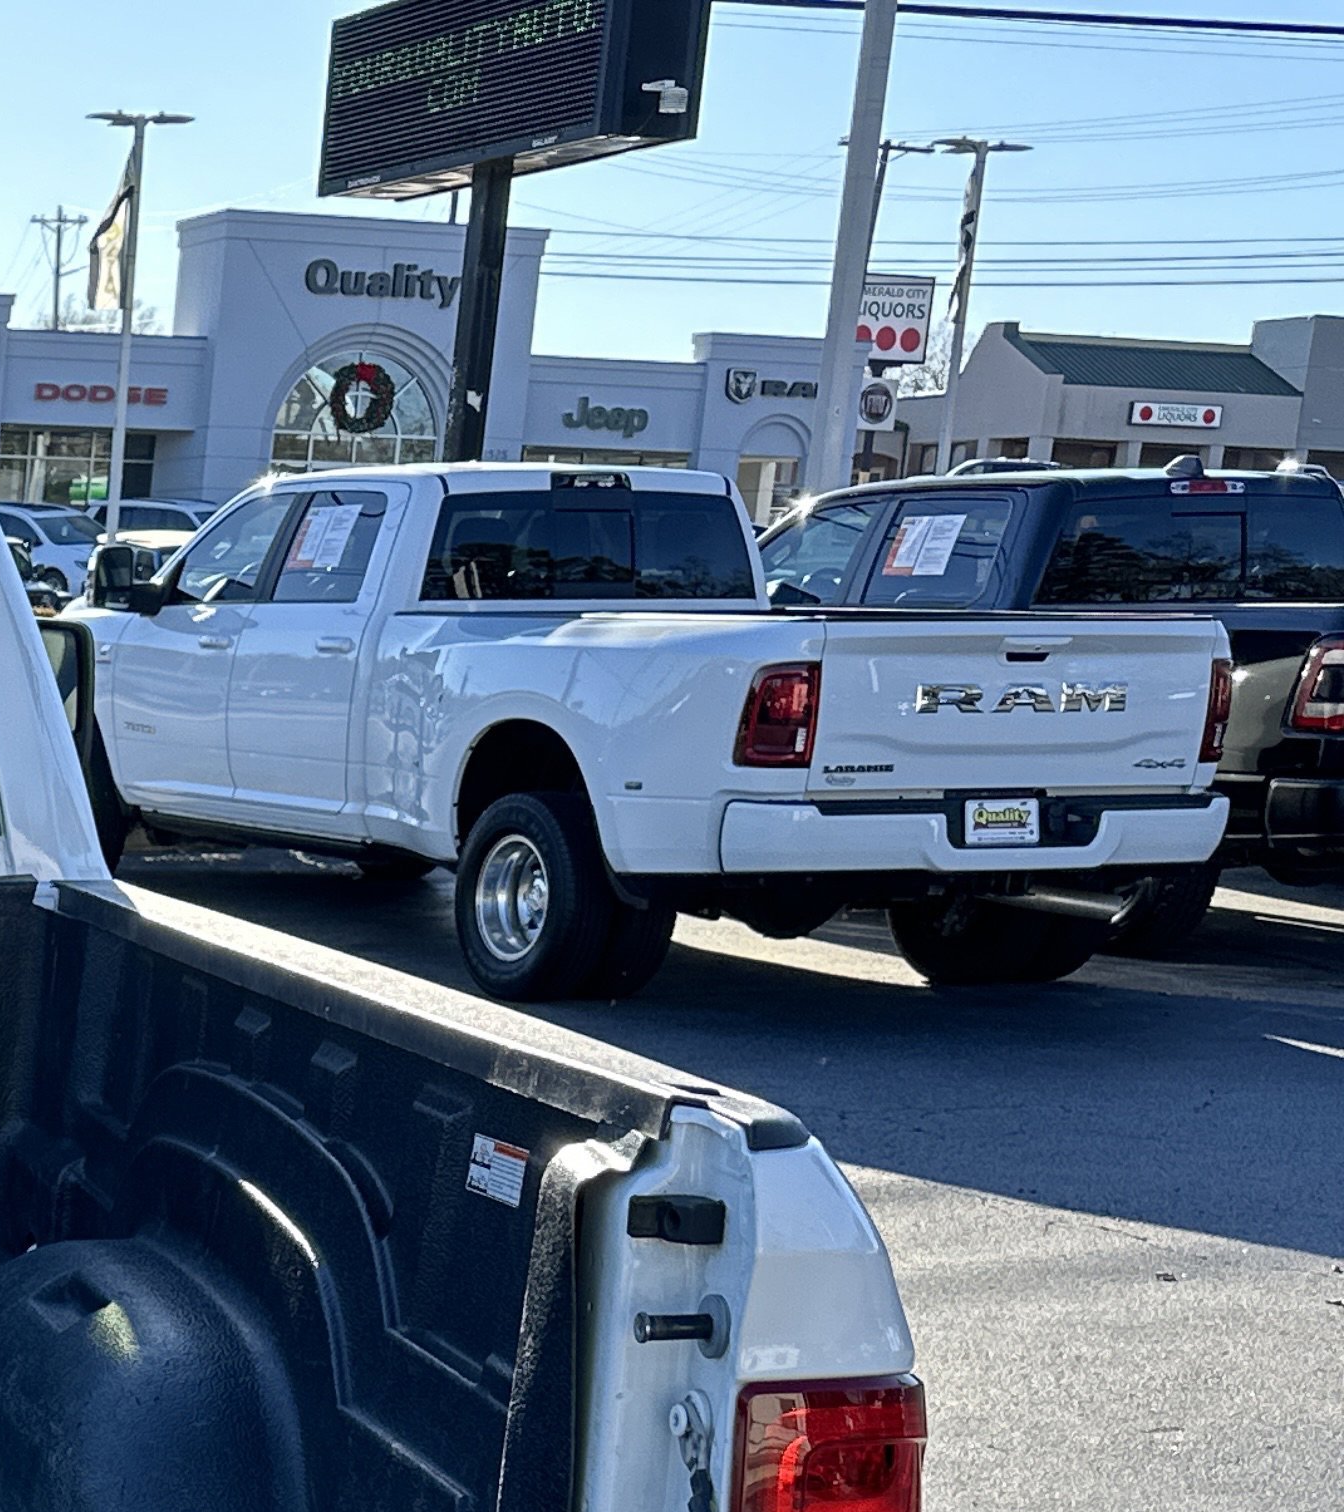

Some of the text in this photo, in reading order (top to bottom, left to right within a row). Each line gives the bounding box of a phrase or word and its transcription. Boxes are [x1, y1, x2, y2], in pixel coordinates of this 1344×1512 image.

[305, 258, 461, 309] Quality
[863, 286, 928, 299] MERALD CITY
[858, 300, 926, 322] IQUORS
[760, 379, 819, 399] RA
[562, 397, 648, 438] Jeep
[916, 683, 1128, 713] RAM
[973, 807, 1031, 824] Quality
